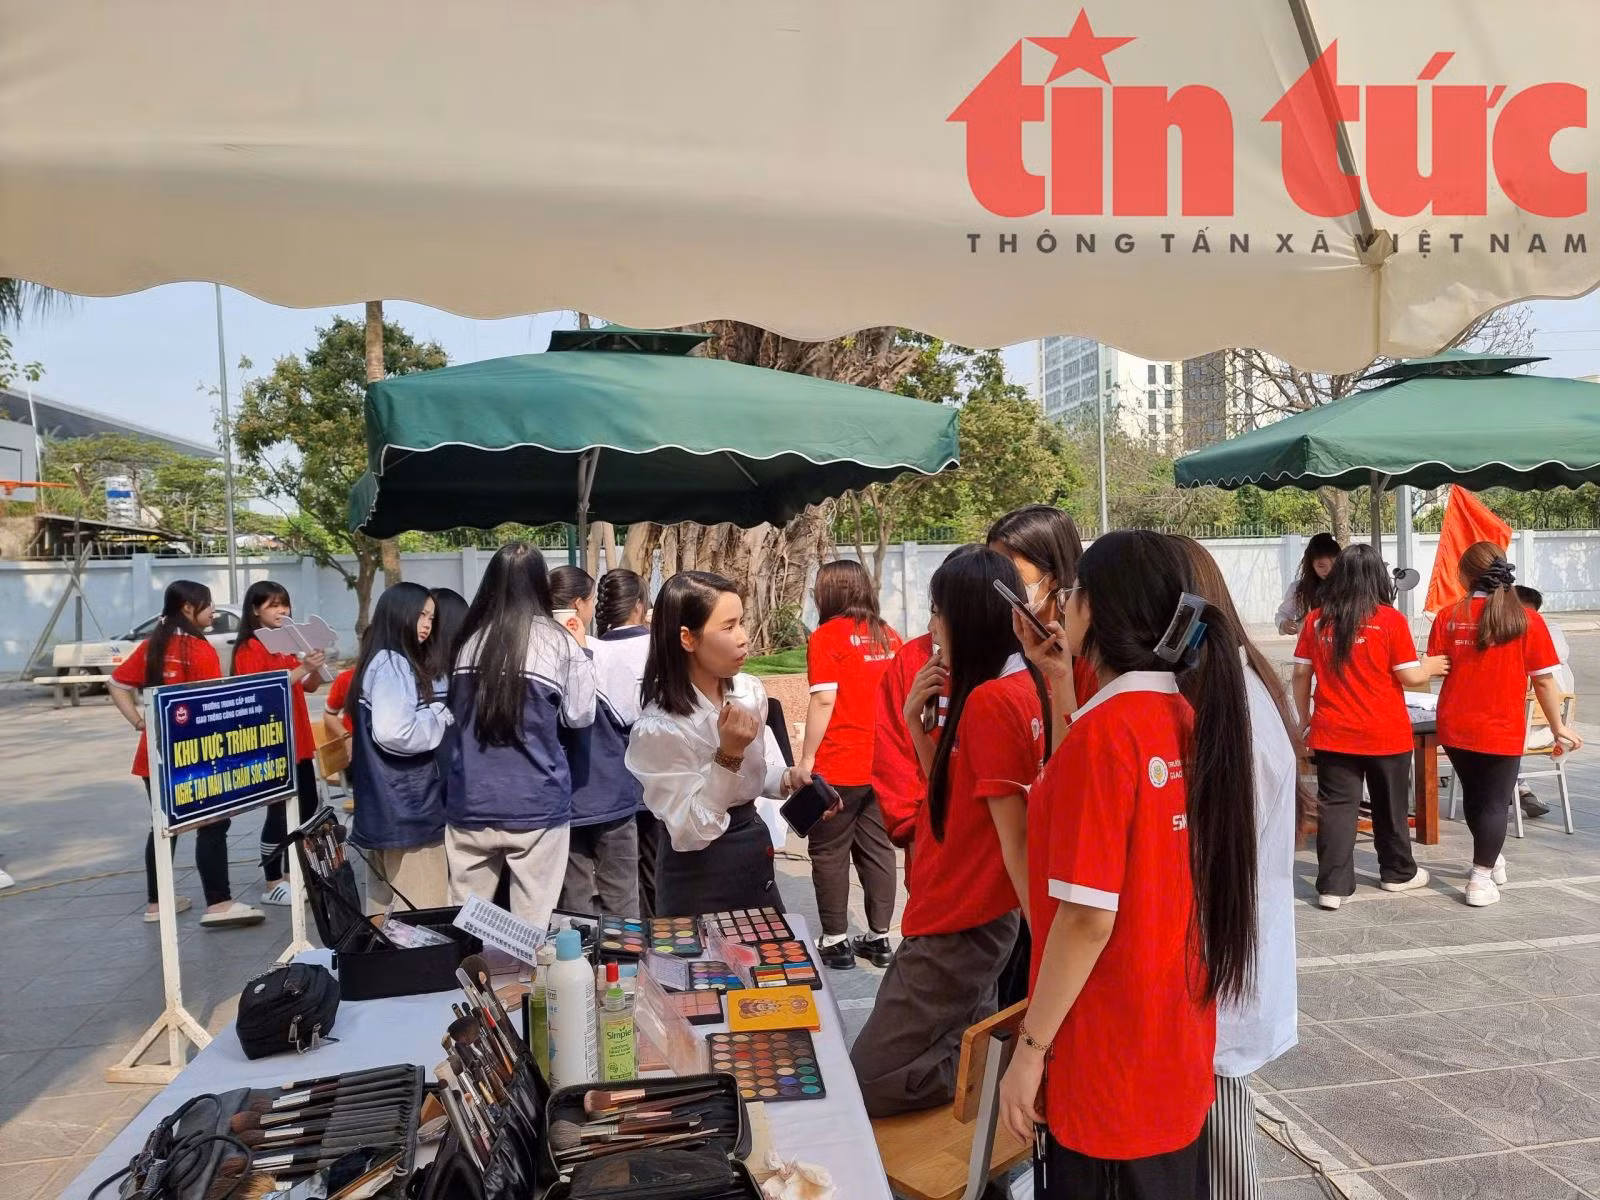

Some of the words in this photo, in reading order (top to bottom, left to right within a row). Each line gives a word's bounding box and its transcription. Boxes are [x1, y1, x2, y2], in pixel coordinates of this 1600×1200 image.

[173, 738, 199, 768] KHU
[200, 731, 224, 766] VỰC
[225, 724, 258, 756] TRÌNH
[259, 714, 284, 748] DIỄN
[174, 773, 194, 807] NGHỀ
[193, 777, 207, 805] TẠO
[207, 765, 223, 798] MẪU
[223, 766, 233, 793] VÀ
[232, 763, 251, 790] CHĂM
[250, 759, 263, 785] SÓC
[263, 752, 275, 782] SẮC
[275, 756, 287, 781] ĐẸP
[606, 1029, 632, 1040] Simple
